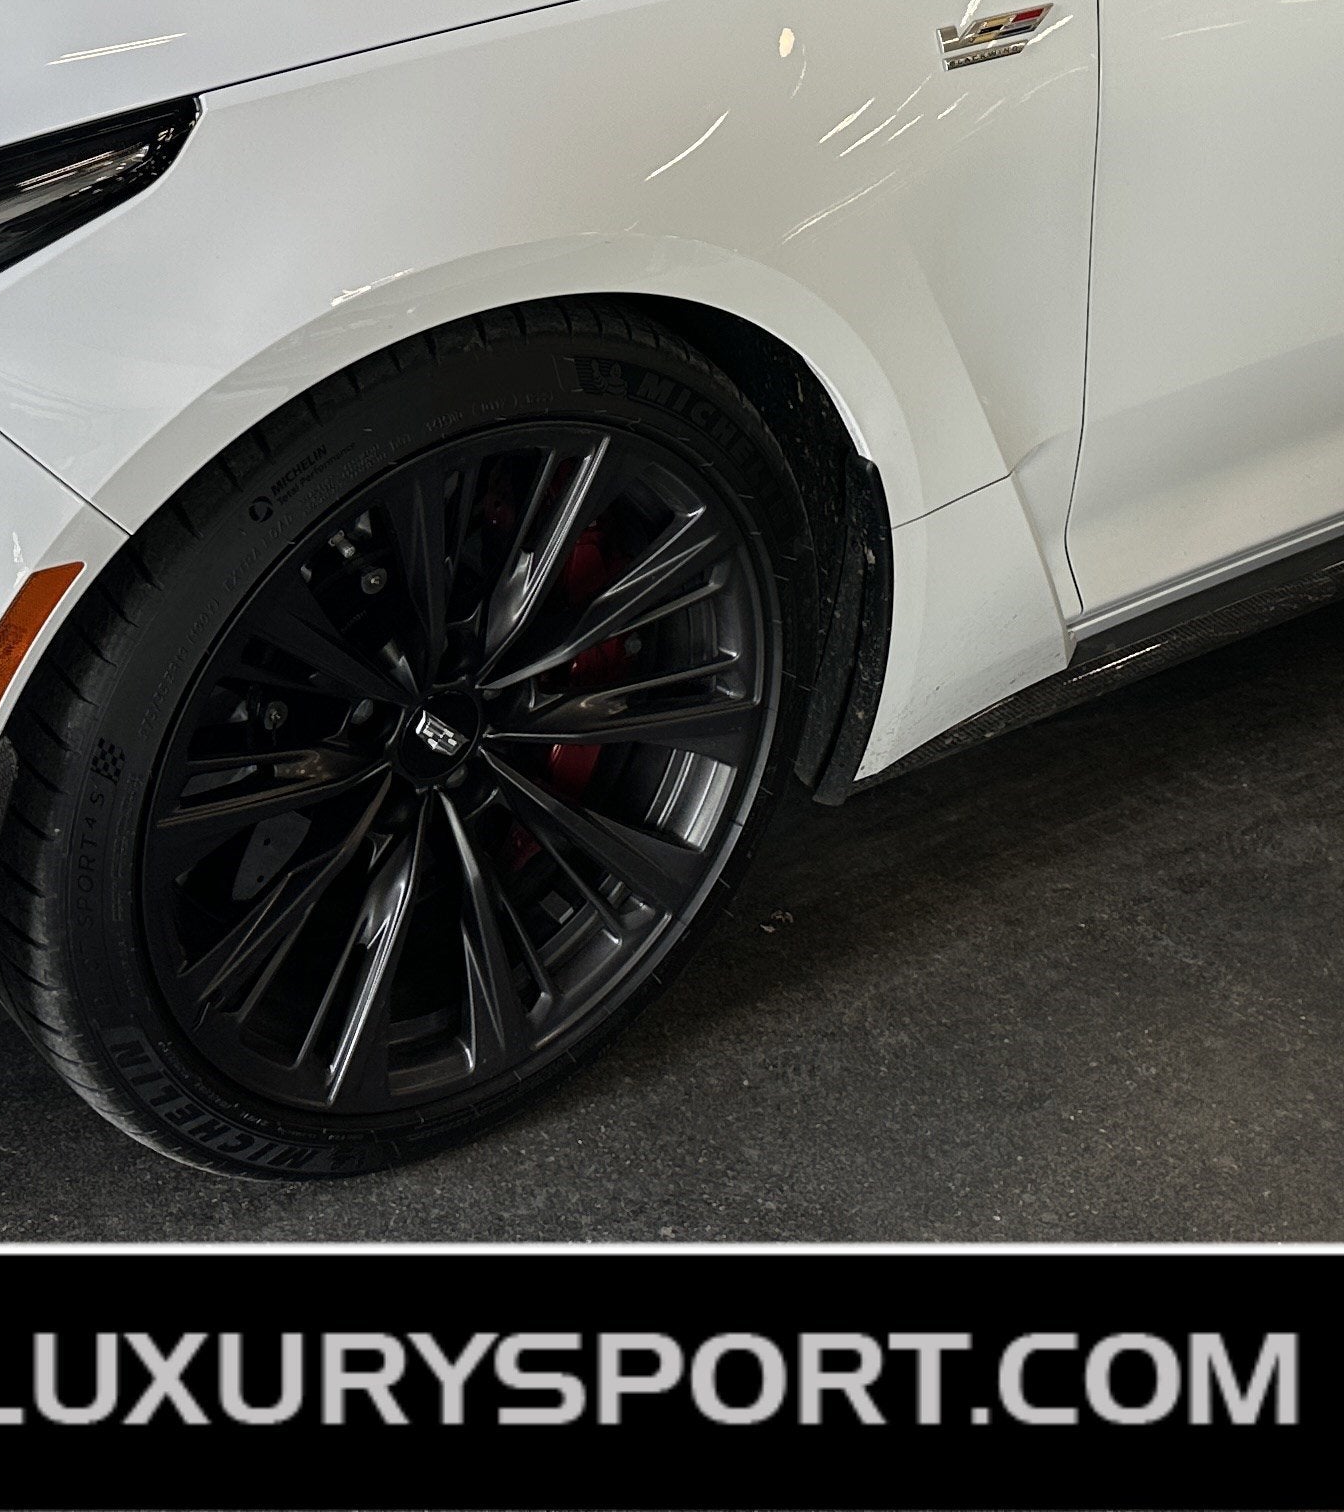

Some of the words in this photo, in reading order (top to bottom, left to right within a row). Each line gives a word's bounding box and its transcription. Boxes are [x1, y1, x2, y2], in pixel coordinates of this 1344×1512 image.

[949, 43, 1024, 68] BLACKWING
[270, 444, 328, 496] MICHELIN
[276, 478, 301, 506] Total
[89, 791, 106, 808] S
[83, 815, 99, 831] 4
[75, 833, 99, 931] SPORT
[110, 1040, 319, 1170] MICHELIN
